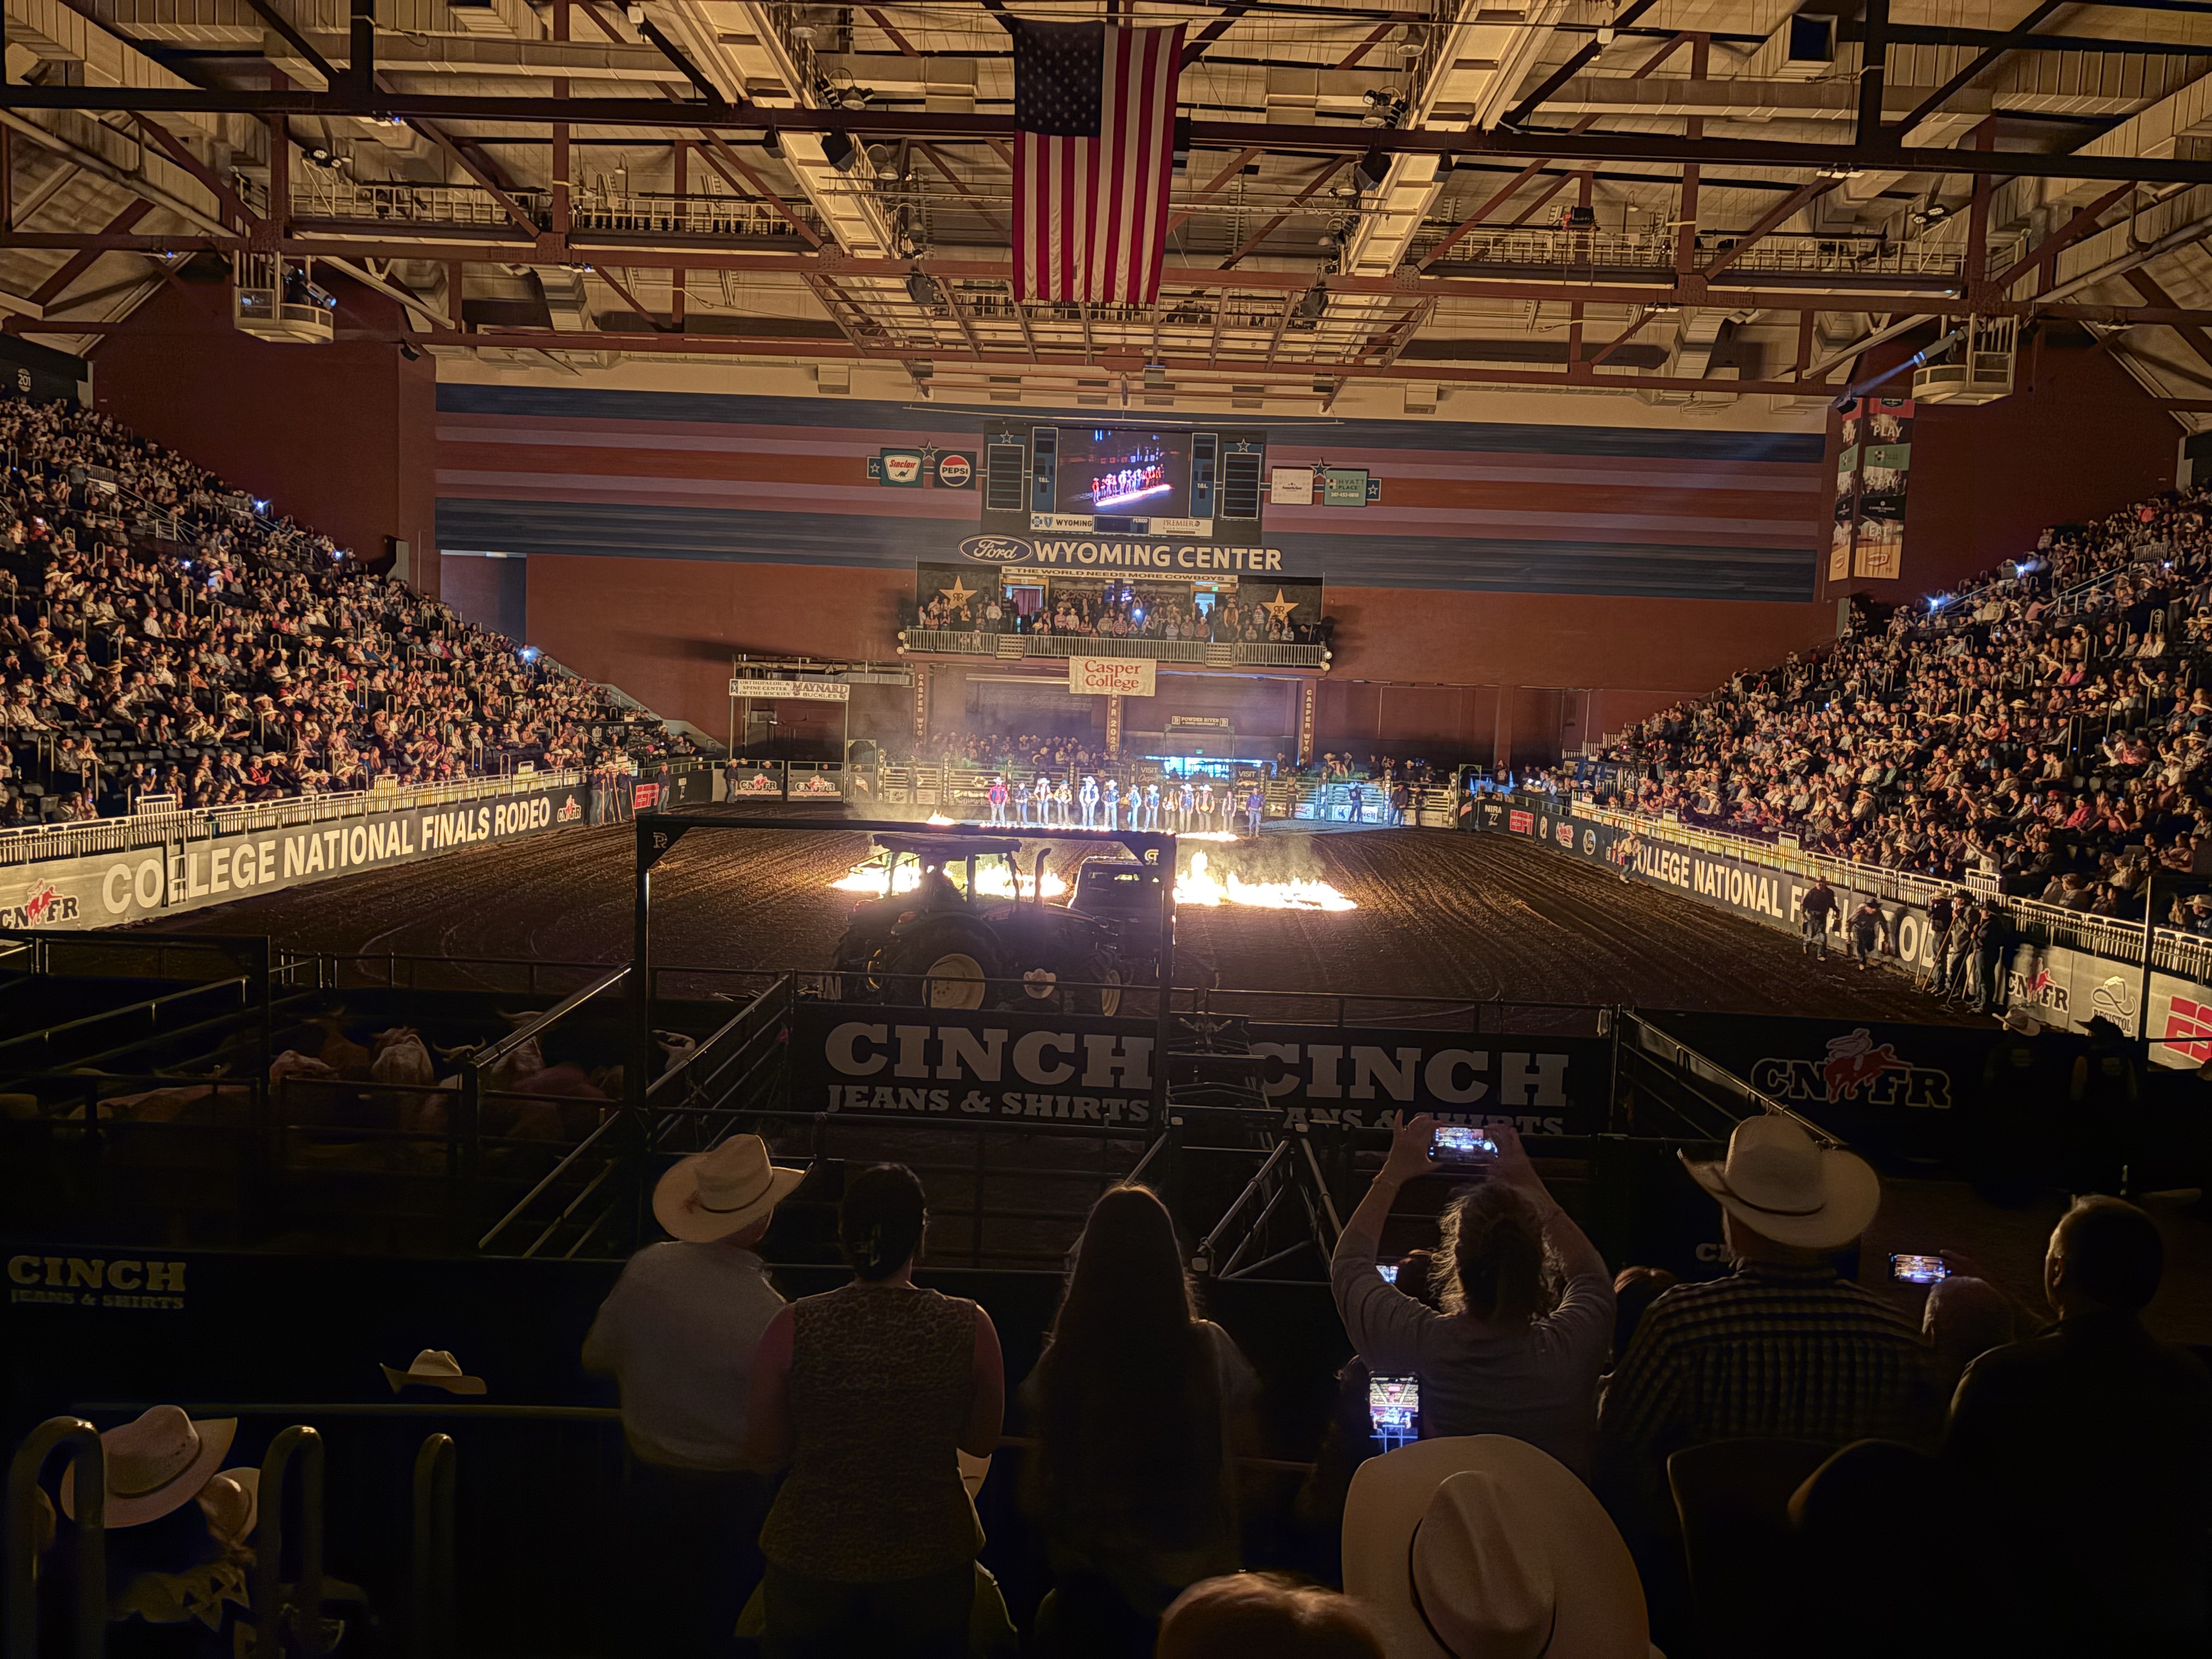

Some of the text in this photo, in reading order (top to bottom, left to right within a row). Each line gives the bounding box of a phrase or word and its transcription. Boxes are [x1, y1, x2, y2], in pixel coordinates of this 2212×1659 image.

[18, 374, 31, 387] 201
[1873, 425, 1903, 437] PLAY
[889, 459, 917, 469] Sinclair
[1869, 526, 1891, 537] EAT
[973, 539, 1018, 559] Ford
[1034, 540, 1282, 571] WYOMING CENTER
[1085, 660, 1142, 678] Casper
[792, 682, 848, 693] MAYNARD
[1085, 674, 1139, 692] College
[1303, 733, 1311, 752] WYO
[1485, 804, 1502, 814] NIRA
[103, 797, 550, 913] COLLEGE NATIONAL FINALS RODEO
[1632, 844, 1690, 889] OLLEGE
[1694, 859, 1783, 919] NATIONAL
[825, 1021, 1154, 1090] CINCH
[1249, 1042, 1570, 1107] CINCH
[827, 1085, 1149, 1122] JEANS & SHIRTS
[1283, 1107, 1363, 1131] ANS
[7, 1255, 188, 1291] CINCH
[81, 1293, 96, 1306] &
